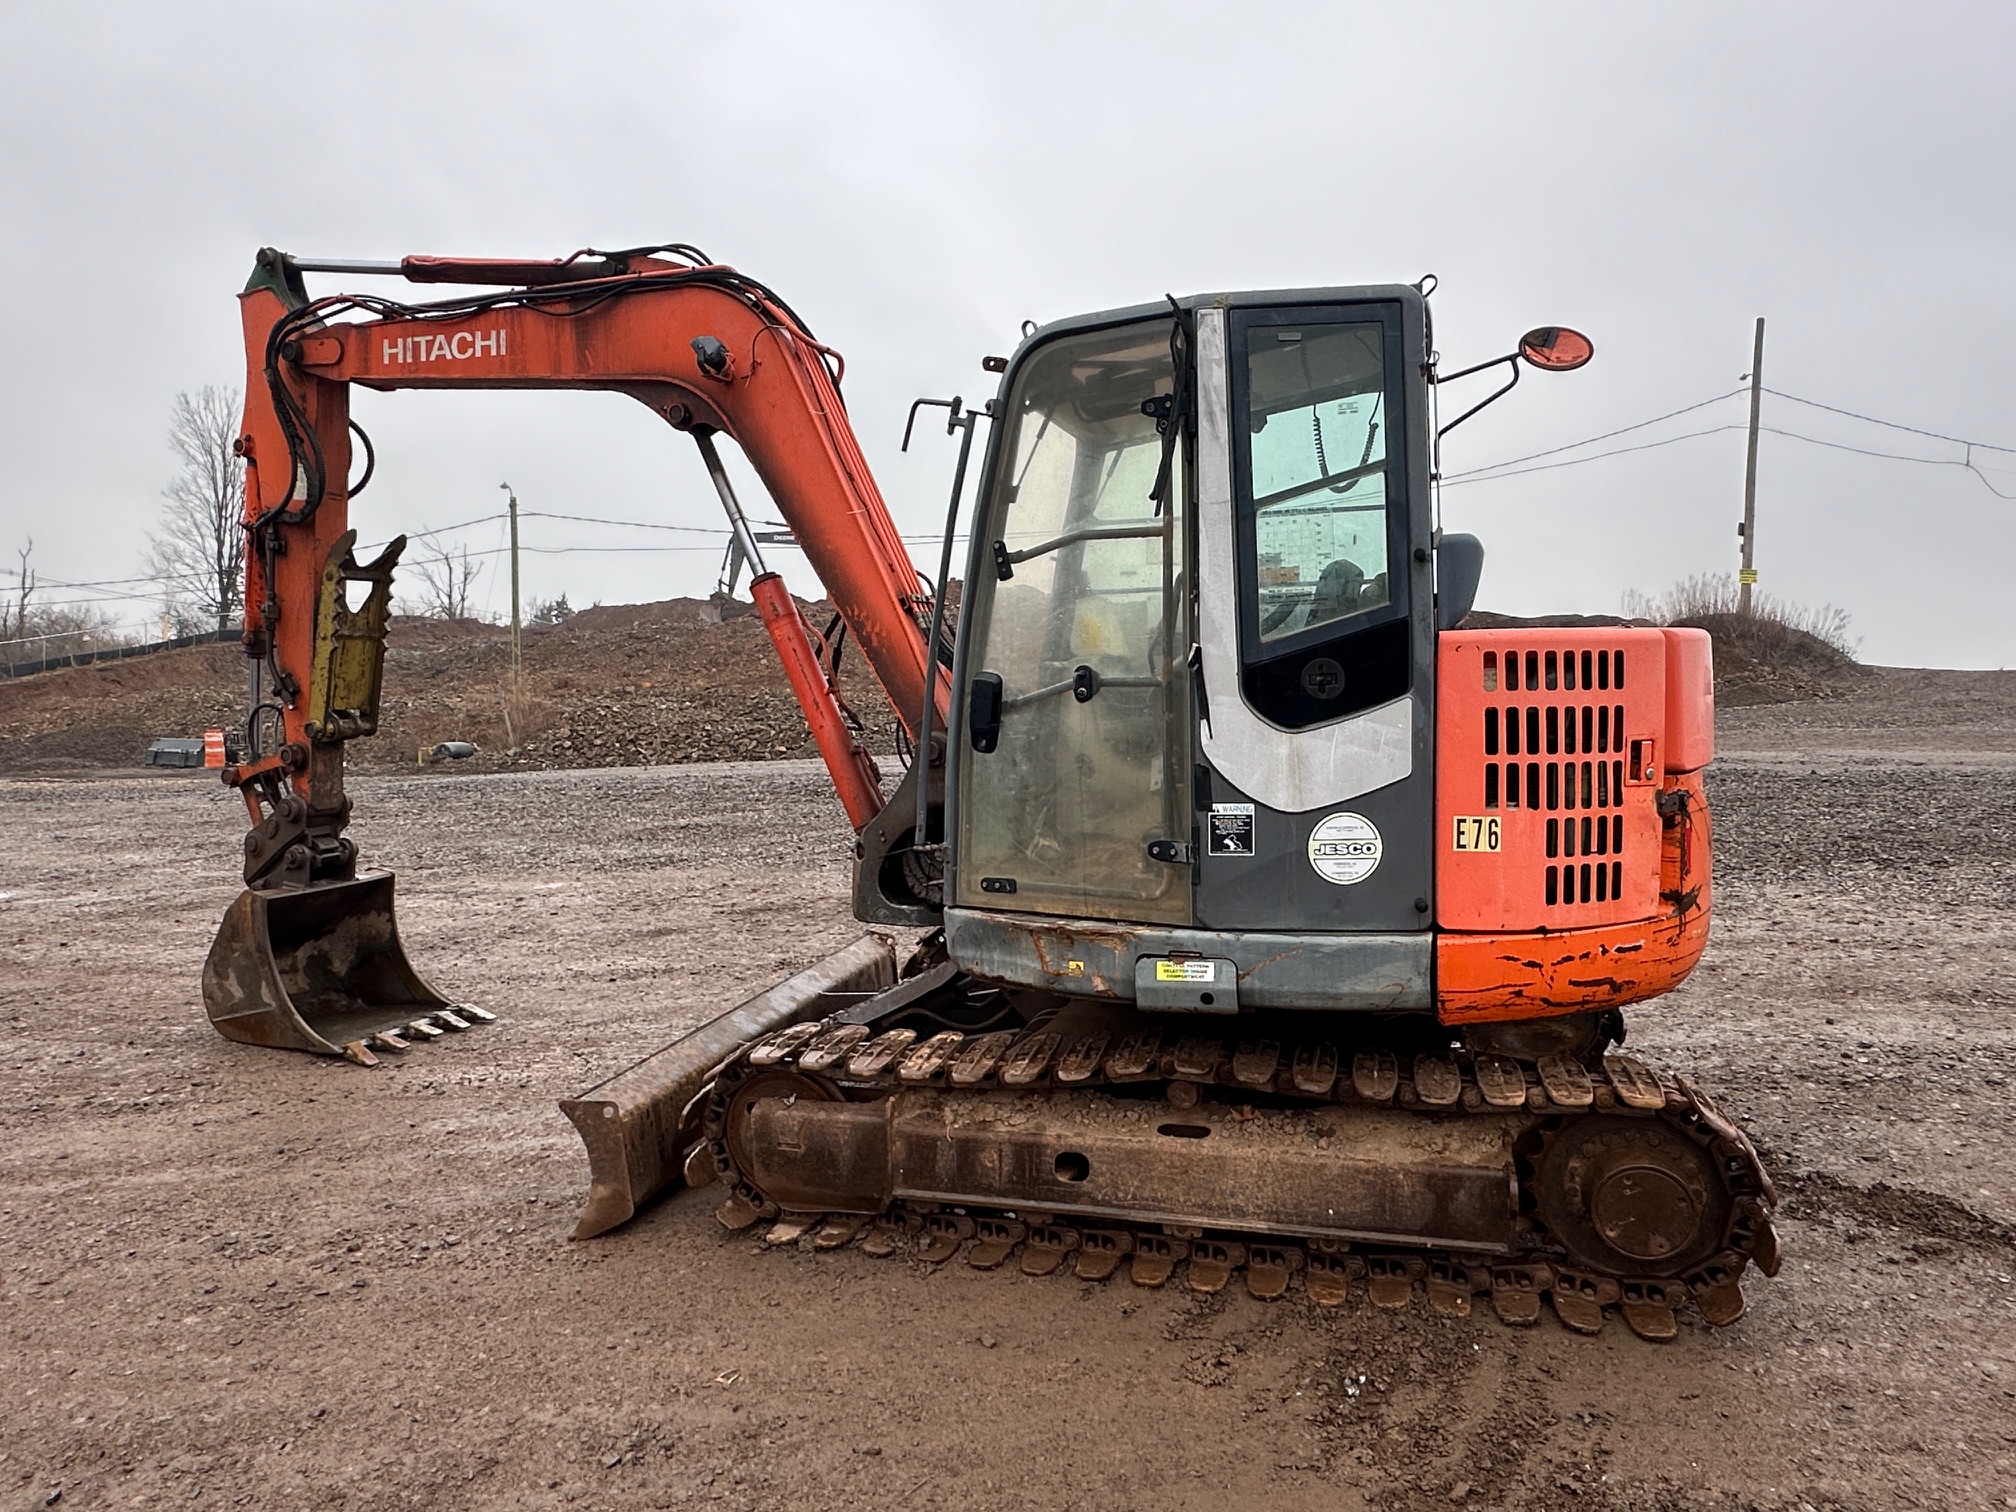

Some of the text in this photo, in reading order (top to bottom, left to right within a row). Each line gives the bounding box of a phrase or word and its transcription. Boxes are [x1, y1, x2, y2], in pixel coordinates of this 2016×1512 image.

[382, 329, 507, 364] HITACHI
[1222, 805, 1253, 813] WARNING
[1456, 818, 1499, 850] E76
[1313, 842, 1377, 856] JESCO
